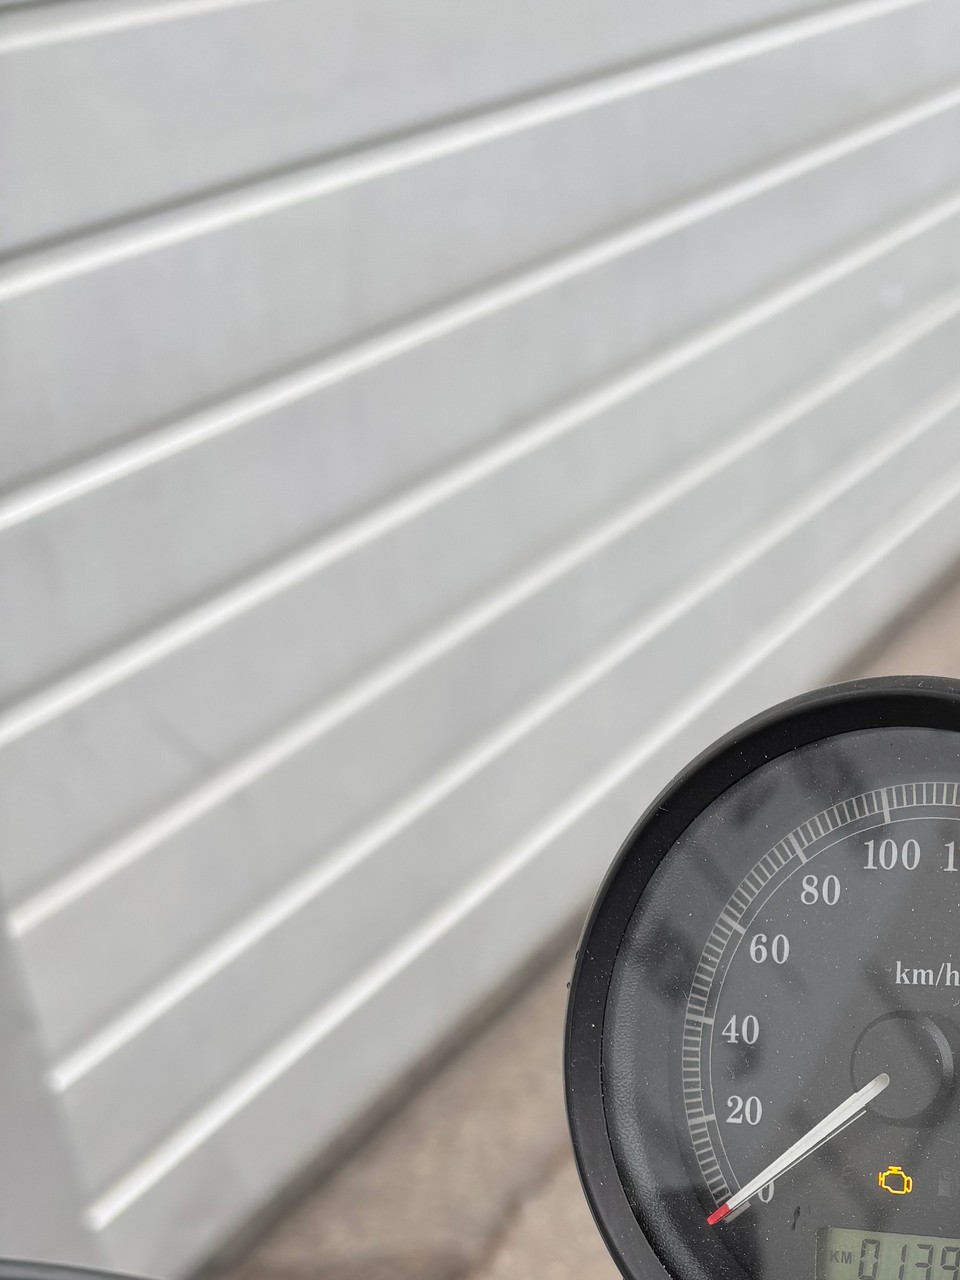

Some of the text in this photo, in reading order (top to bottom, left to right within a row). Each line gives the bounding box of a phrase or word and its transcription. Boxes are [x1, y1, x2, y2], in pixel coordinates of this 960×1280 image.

[863, 838, 921, 872] 100
[800, 874, 841, 906] 80
[749, 933, 790, 965] 60
[895, 960, 960, 987] km/h
[721, 1014, 760, 1045] 40
[725, 1095, 763, 1126] 20
[829, 1249, 853, 1265] KM
